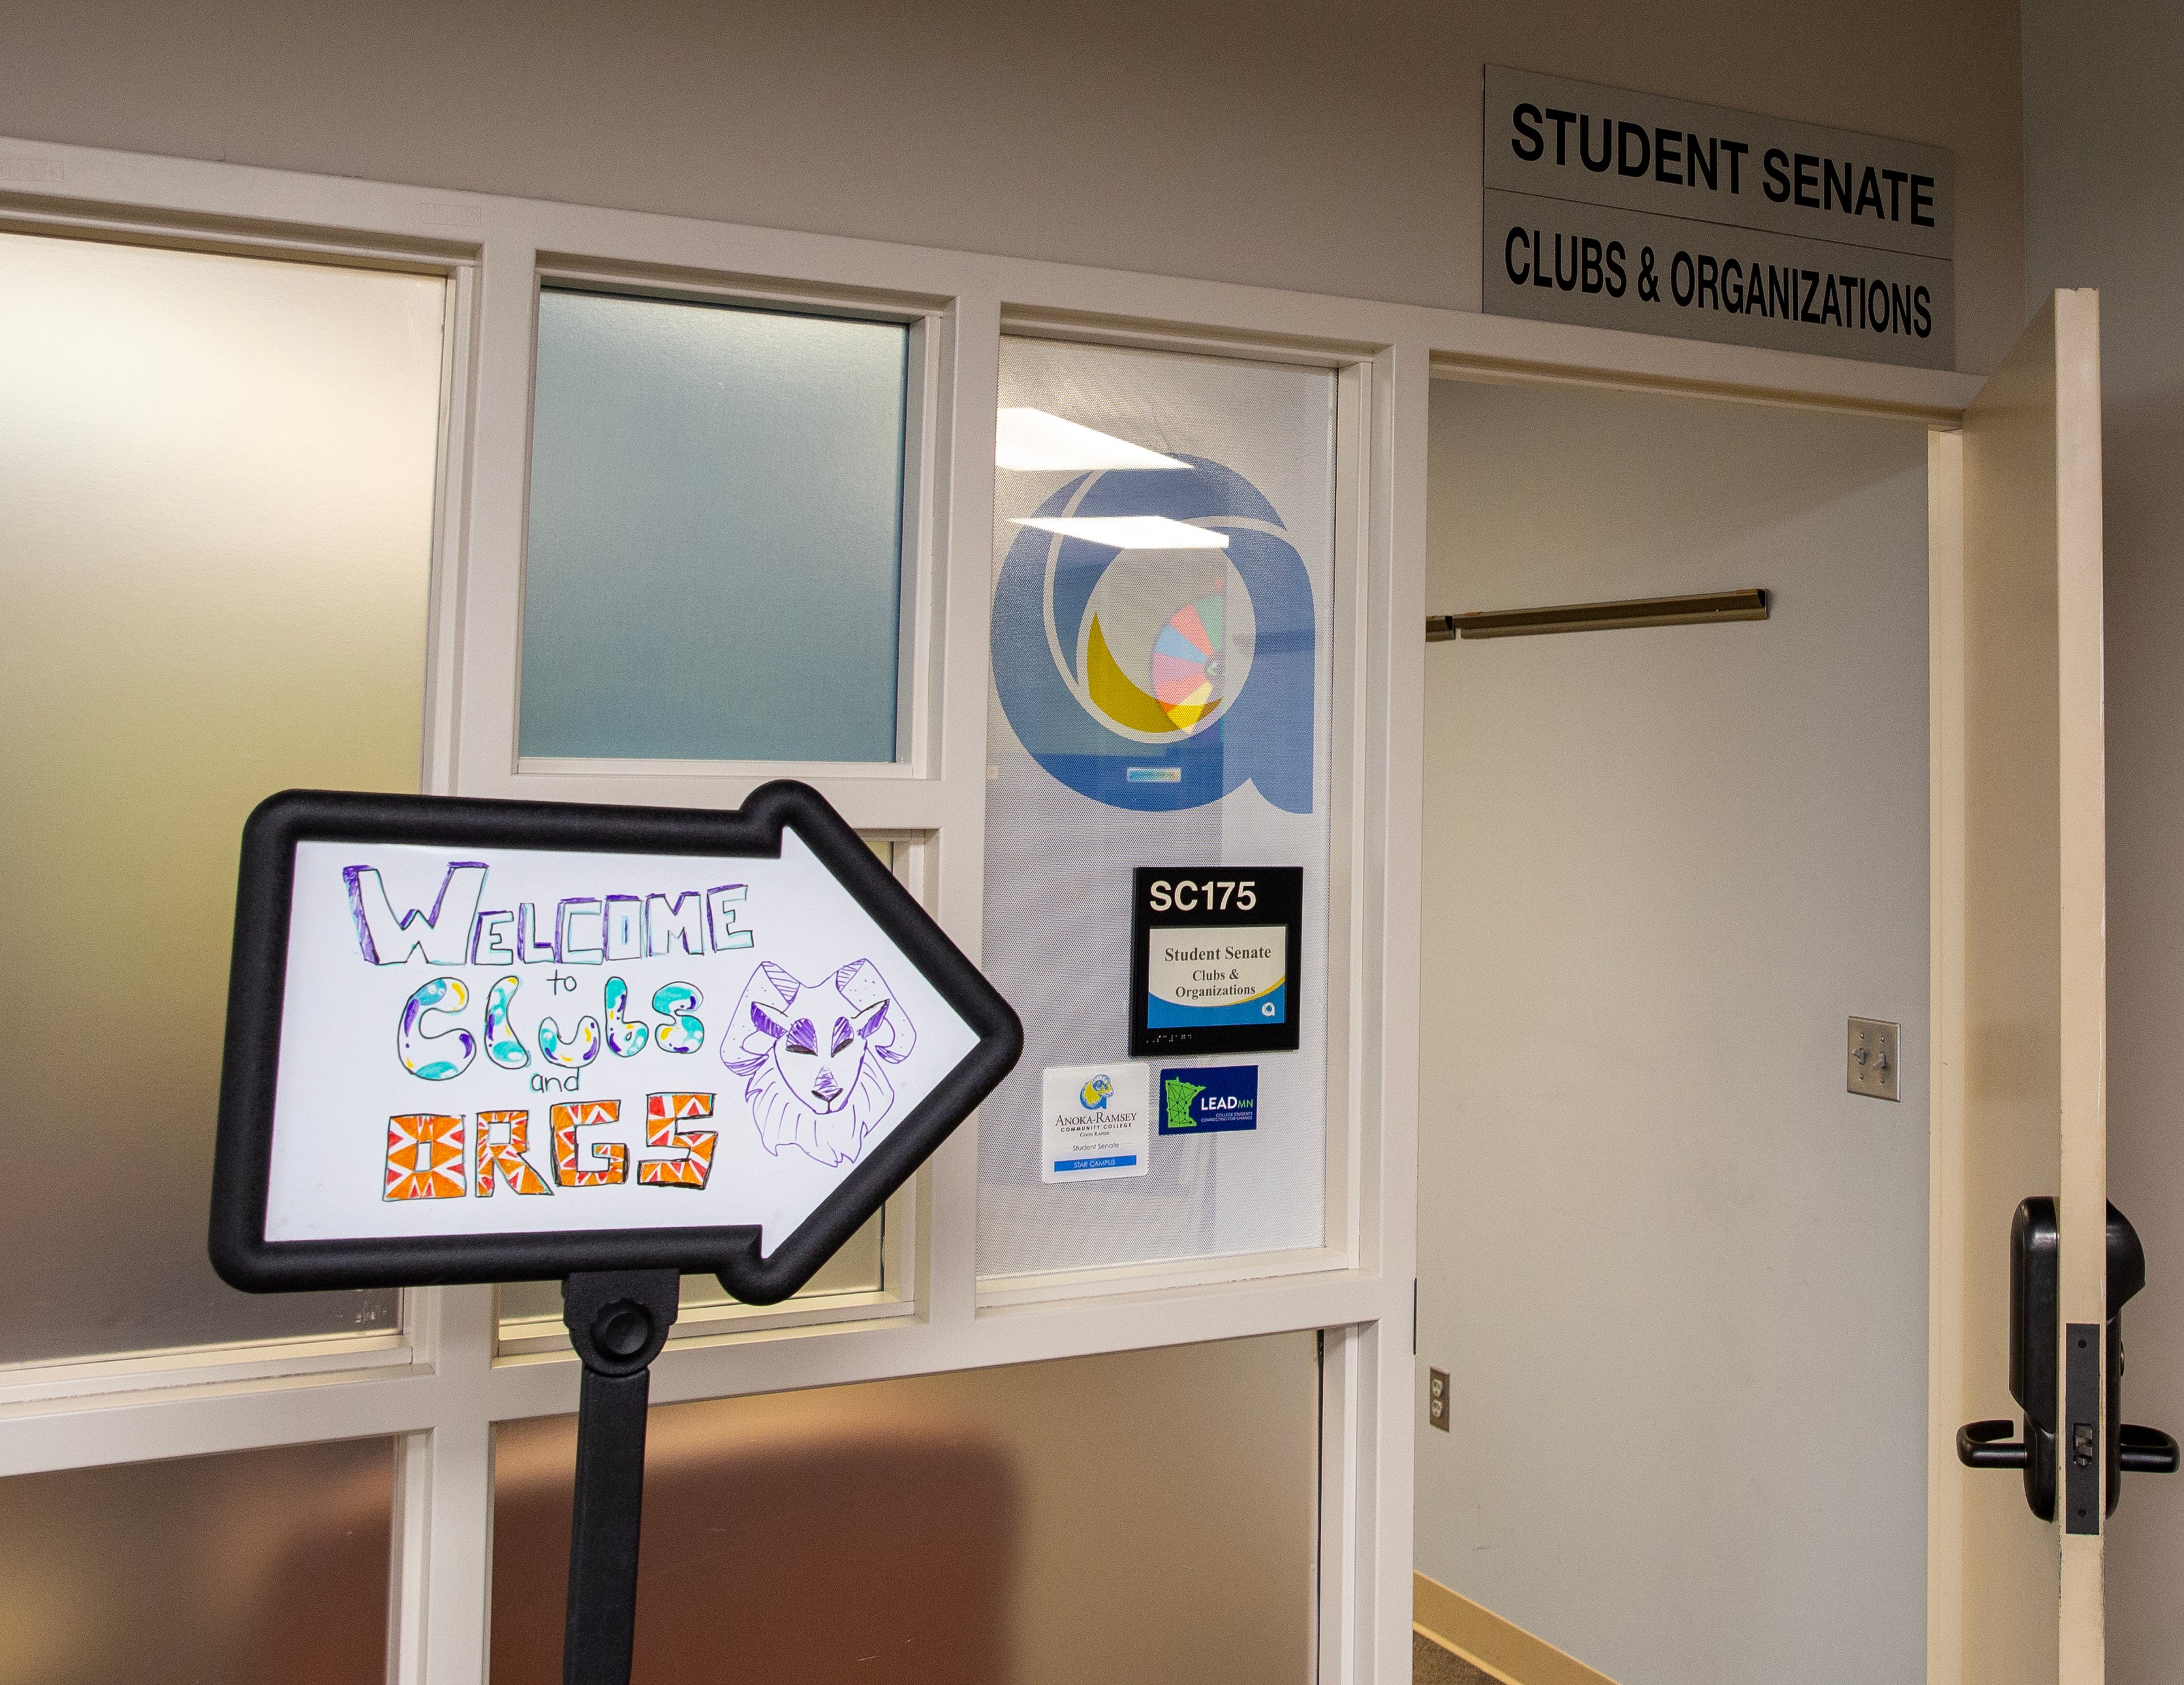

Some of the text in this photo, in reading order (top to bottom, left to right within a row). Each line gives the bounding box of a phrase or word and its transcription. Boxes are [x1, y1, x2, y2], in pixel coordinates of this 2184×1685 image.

[1510, 102, 1935, 228] STUDENT SENATE
[1505, 226, 1933, 338] CLUBS & ORGANIZATIONS
[1149, 880, 1256, 911] SC175
[343, 861, 755, 966] WELCOME
[1164, 946, 1271, 962] Student Senate
[547, 969, 578, 995] to
[1193, 969, 1240, 981] Clubs &
[1176, 984, 1256, 1000] Organizations
[531, 1067, 581, 1094] and
[1055, 1112, 1137, 1126] ANOKA-RAMSEY
[382, 1092, 719, 1201] ORGS
[1089, 1159, 1115, 1167] CAMPUS
